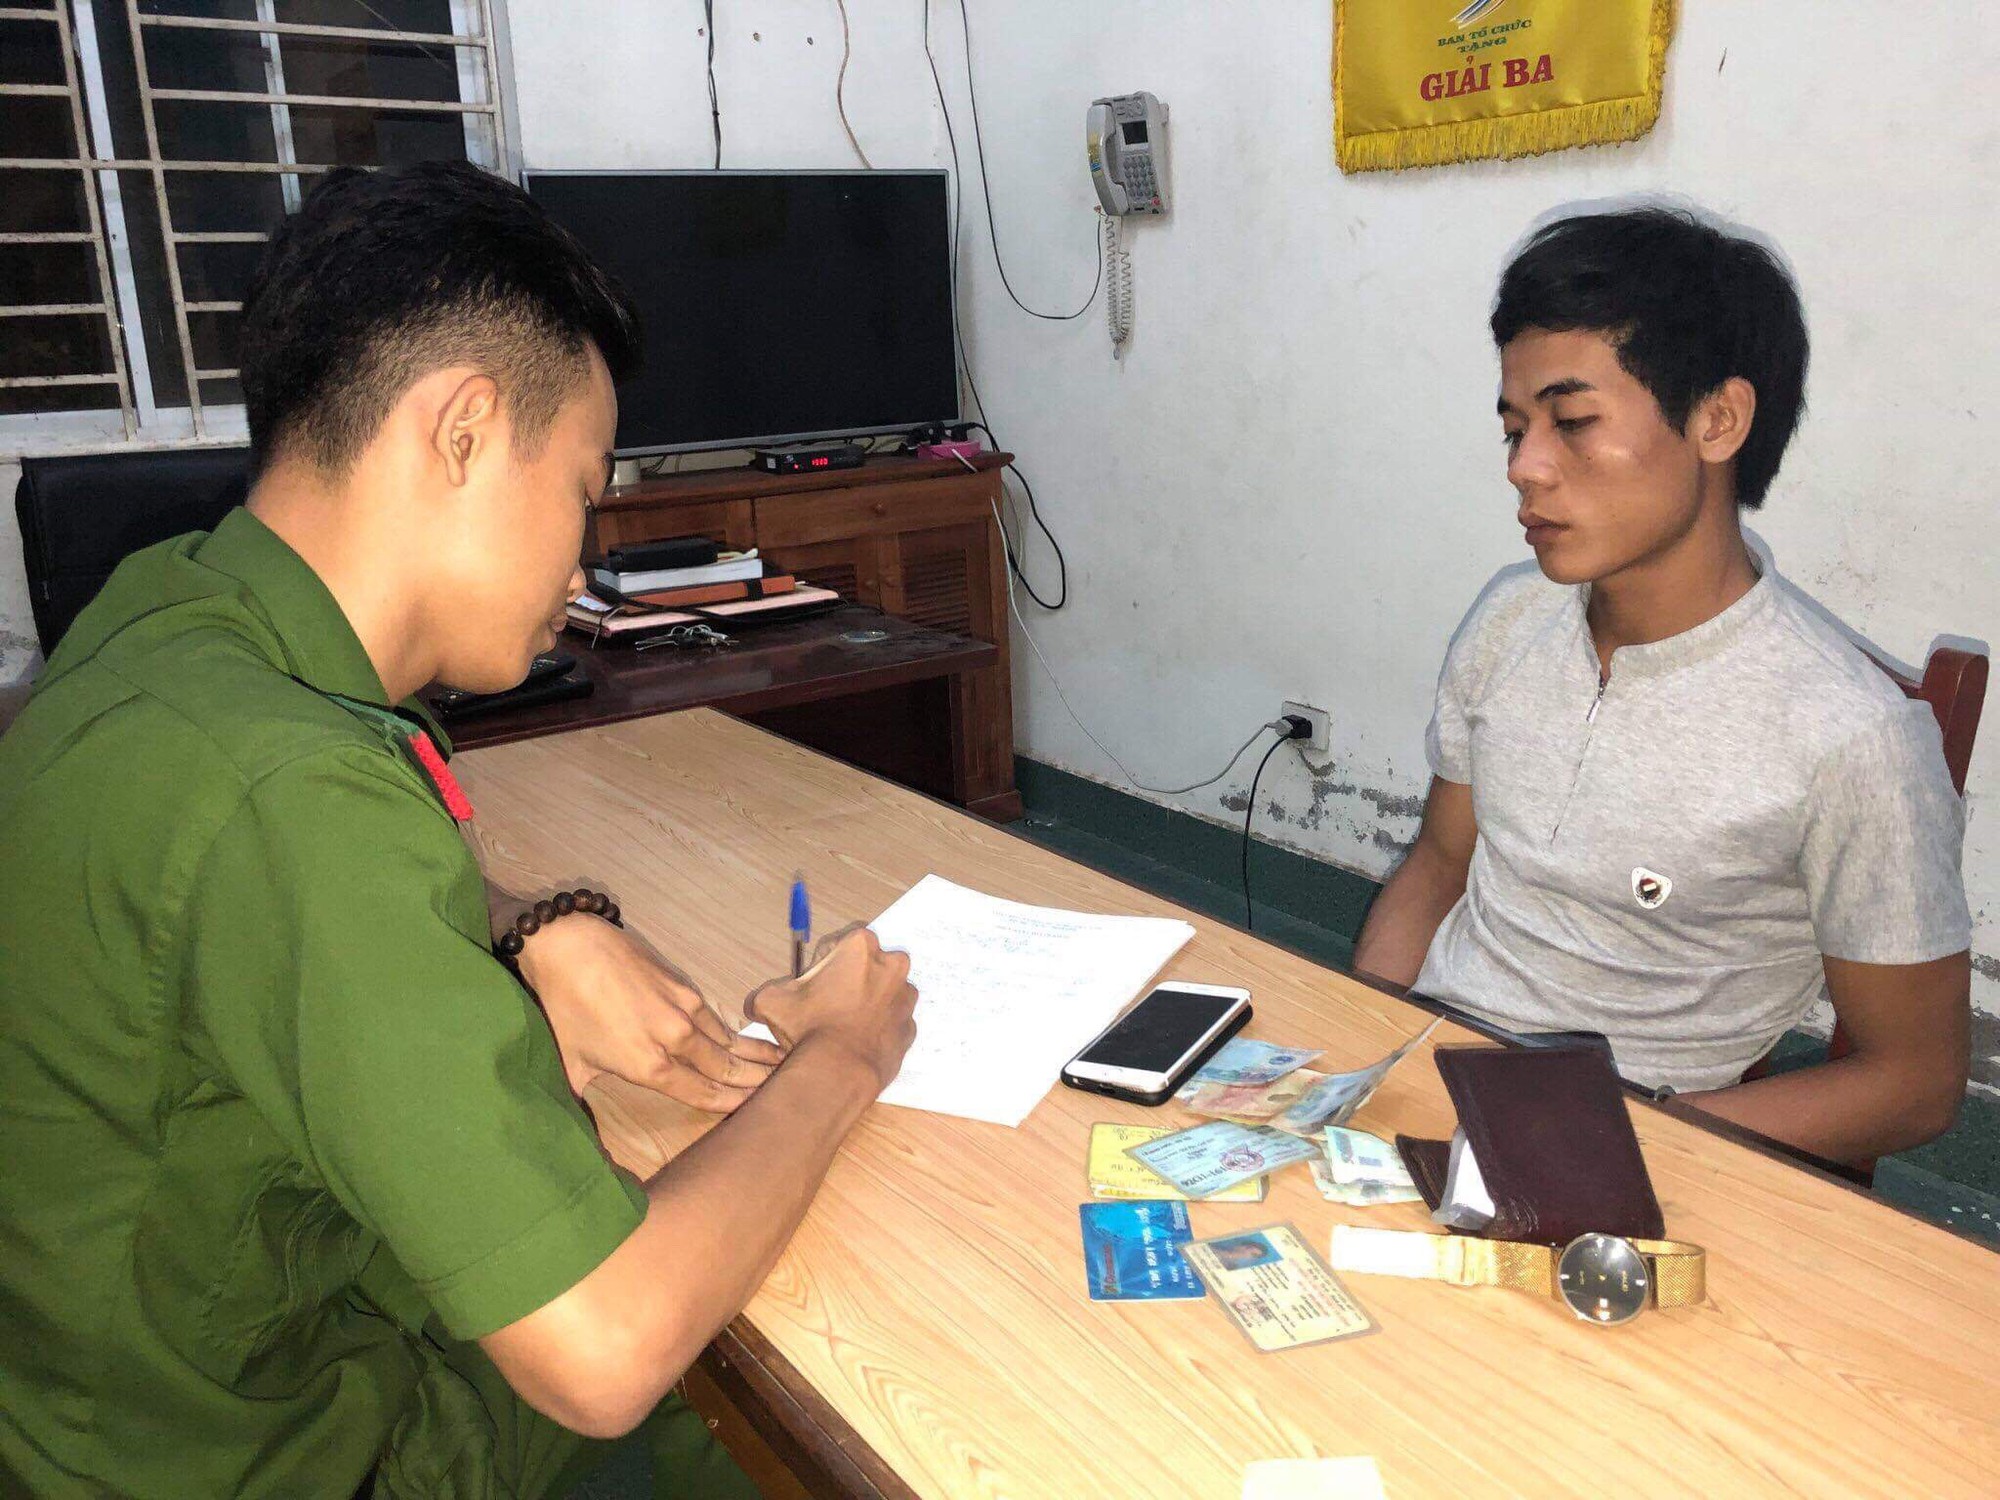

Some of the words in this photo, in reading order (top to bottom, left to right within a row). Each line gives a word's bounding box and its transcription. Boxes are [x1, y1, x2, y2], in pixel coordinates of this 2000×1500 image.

[1437, 34, 1464, 46] BAN
[1491, 19, 1532, 34] CHỨC
[1420, 55, 1492, 101] GIẢI
[1502, 54, 1554, 88] BA
